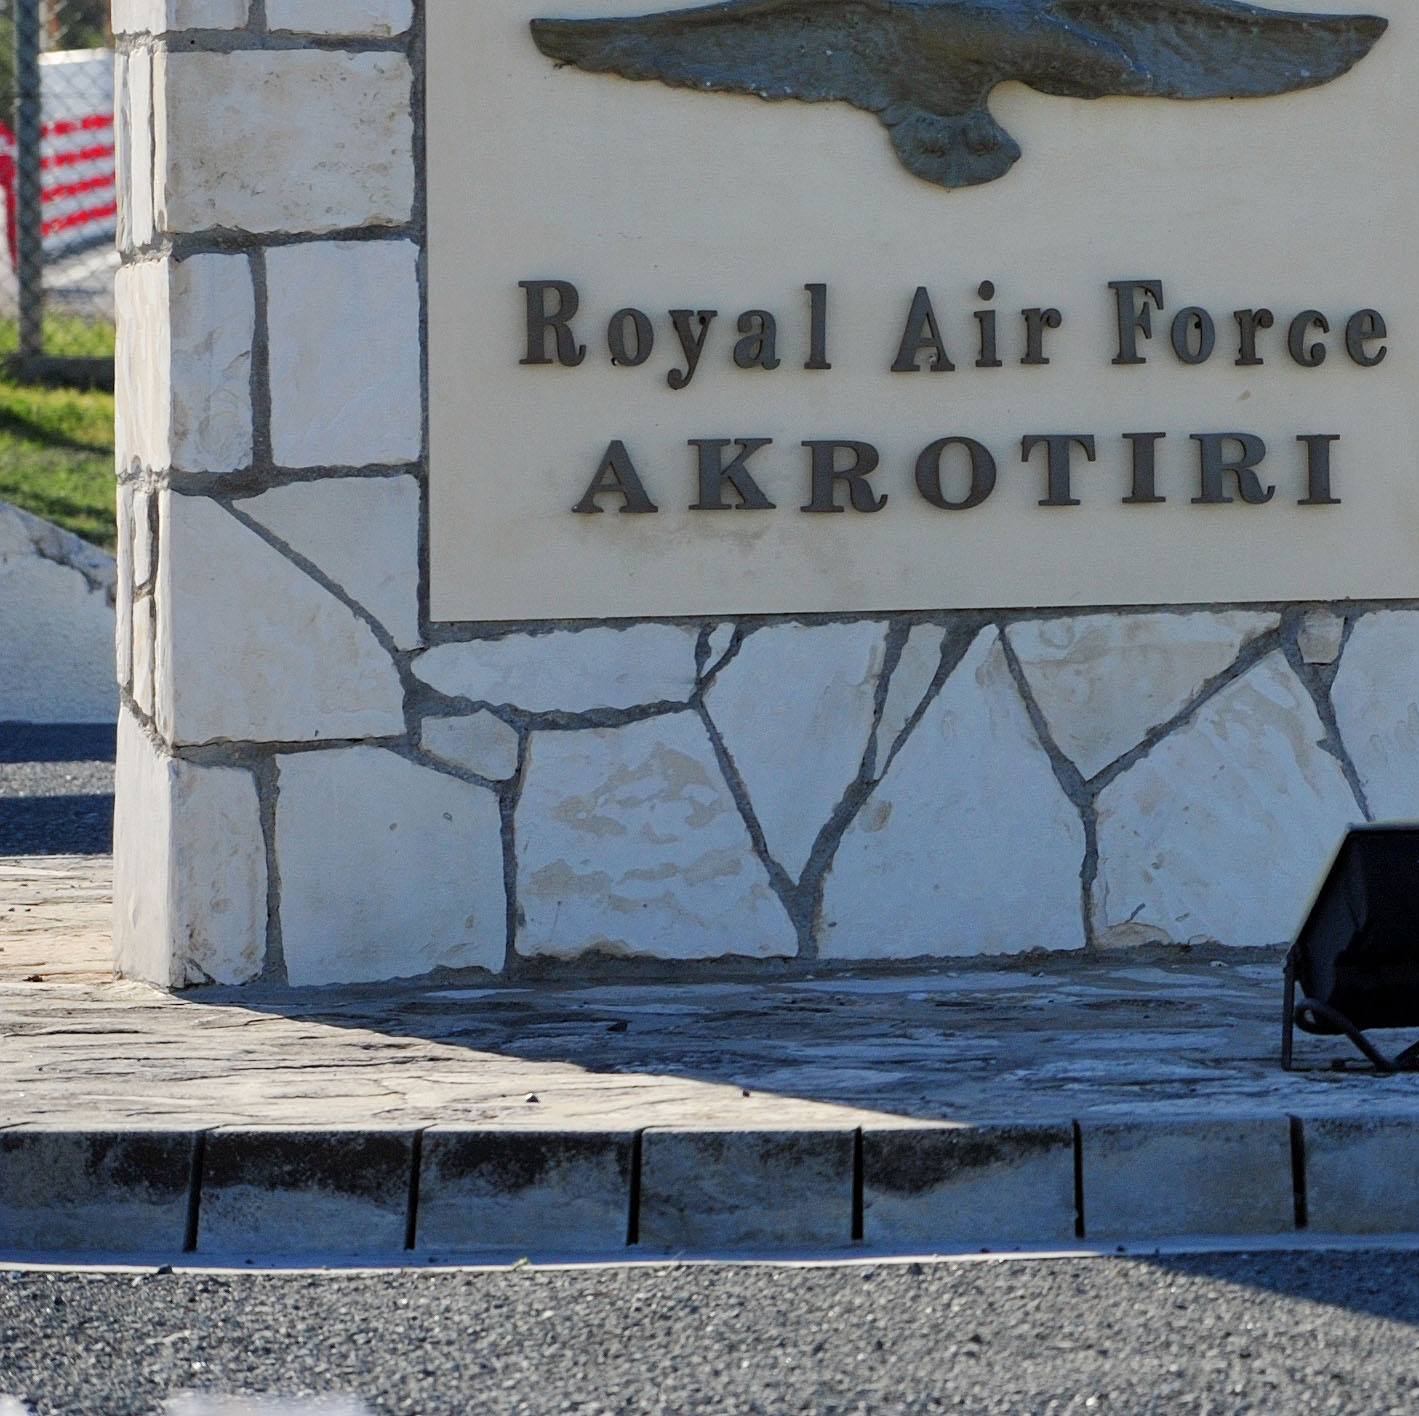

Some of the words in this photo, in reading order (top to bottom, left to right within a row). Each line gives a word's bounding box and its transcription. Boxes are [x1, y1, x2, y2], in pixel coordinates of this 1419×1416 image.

[517, 279, 832, 391] Royal
[889, 279, 1063, 374] Air
[1107, 279, 1389, 369] Force
[570, 431, 1343, 516] AKROTIRI
